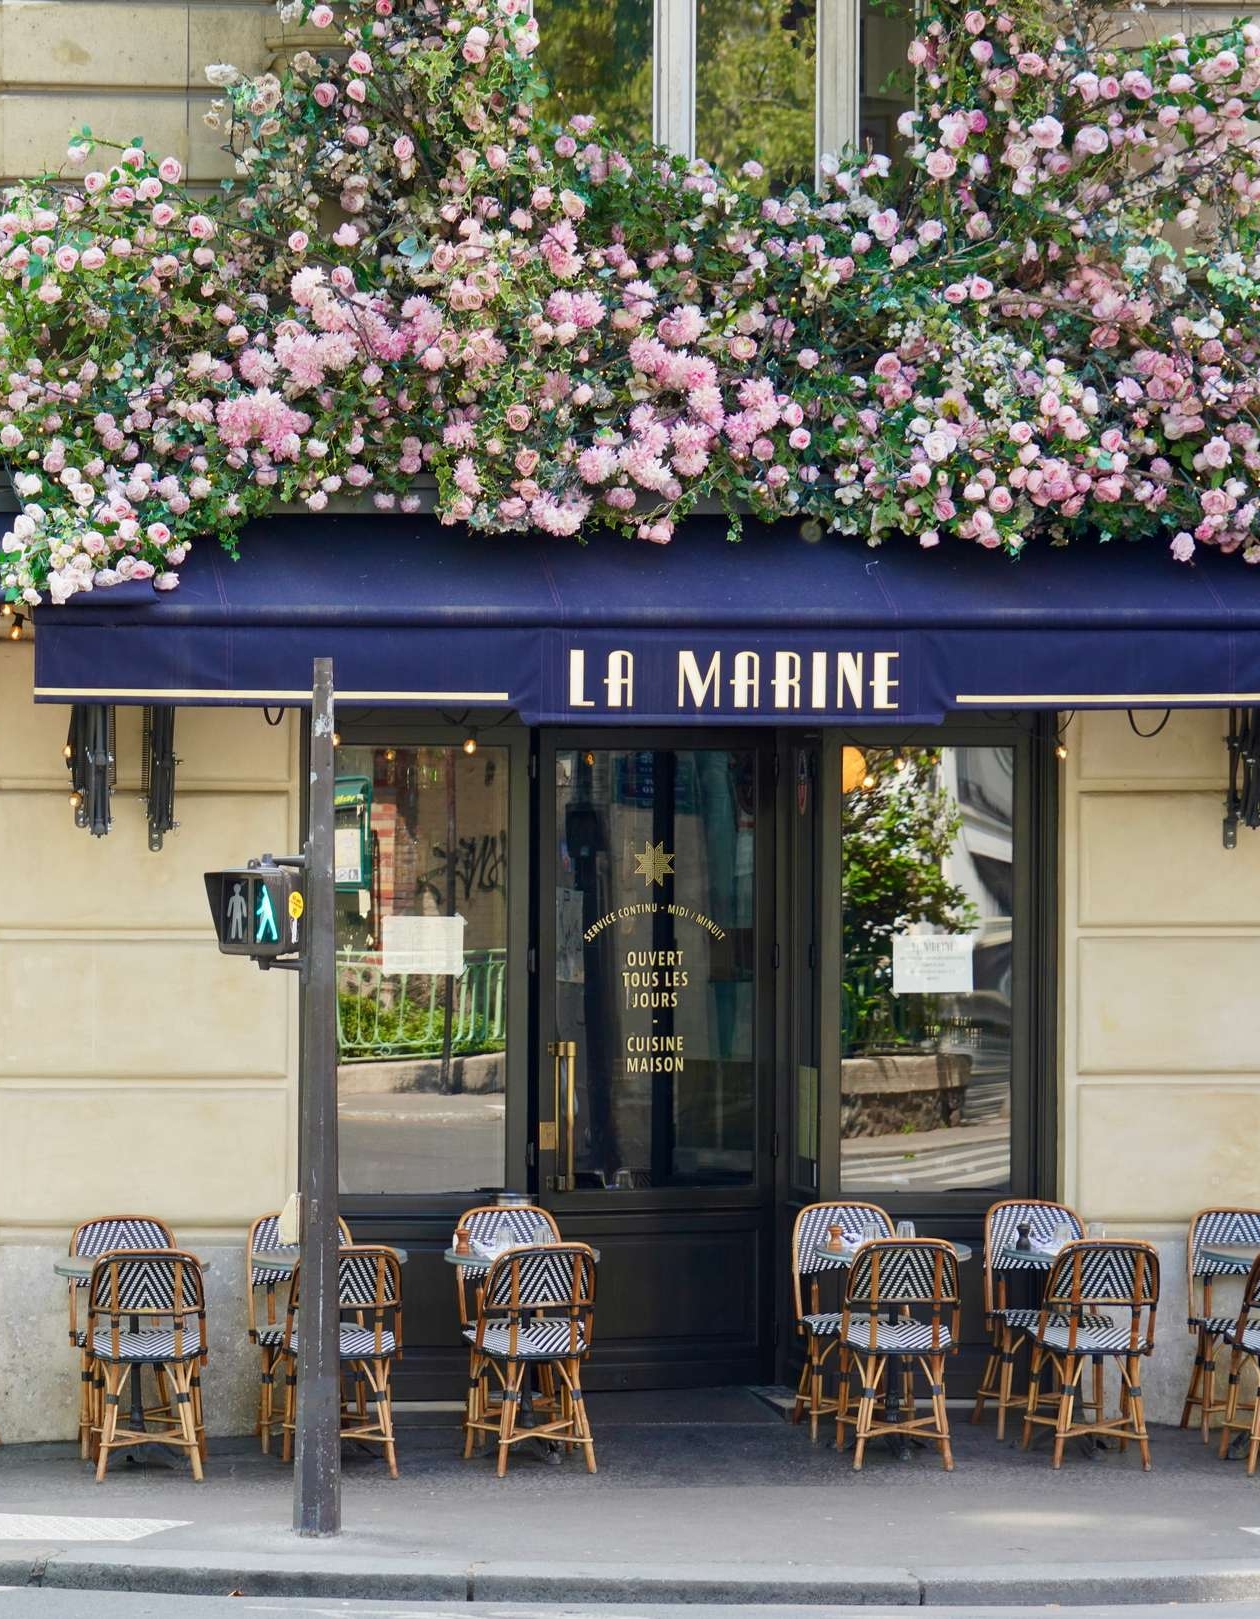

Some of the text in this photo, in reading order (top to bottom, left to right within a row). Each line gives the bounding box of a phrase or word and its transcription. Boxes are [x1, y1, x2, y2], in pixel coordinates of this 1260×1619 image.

[569, 649, 899, 709] LA MARINE
[583, 912, 617, 943] SERVICE
[618, 903, 658, 919] CONTINU
[668, 904, 689, 918] MIDI
[695, 914, 727, 941] MINUIT
[627, 951, 684, 967] OUVERT
[622, 971, 689, 988] TOUS LES
[632, 992, 678, 1008] JOURS
[627, 1036, 684, 1052] CUISINE
[627, 1056, 684, 1073] MAISON
